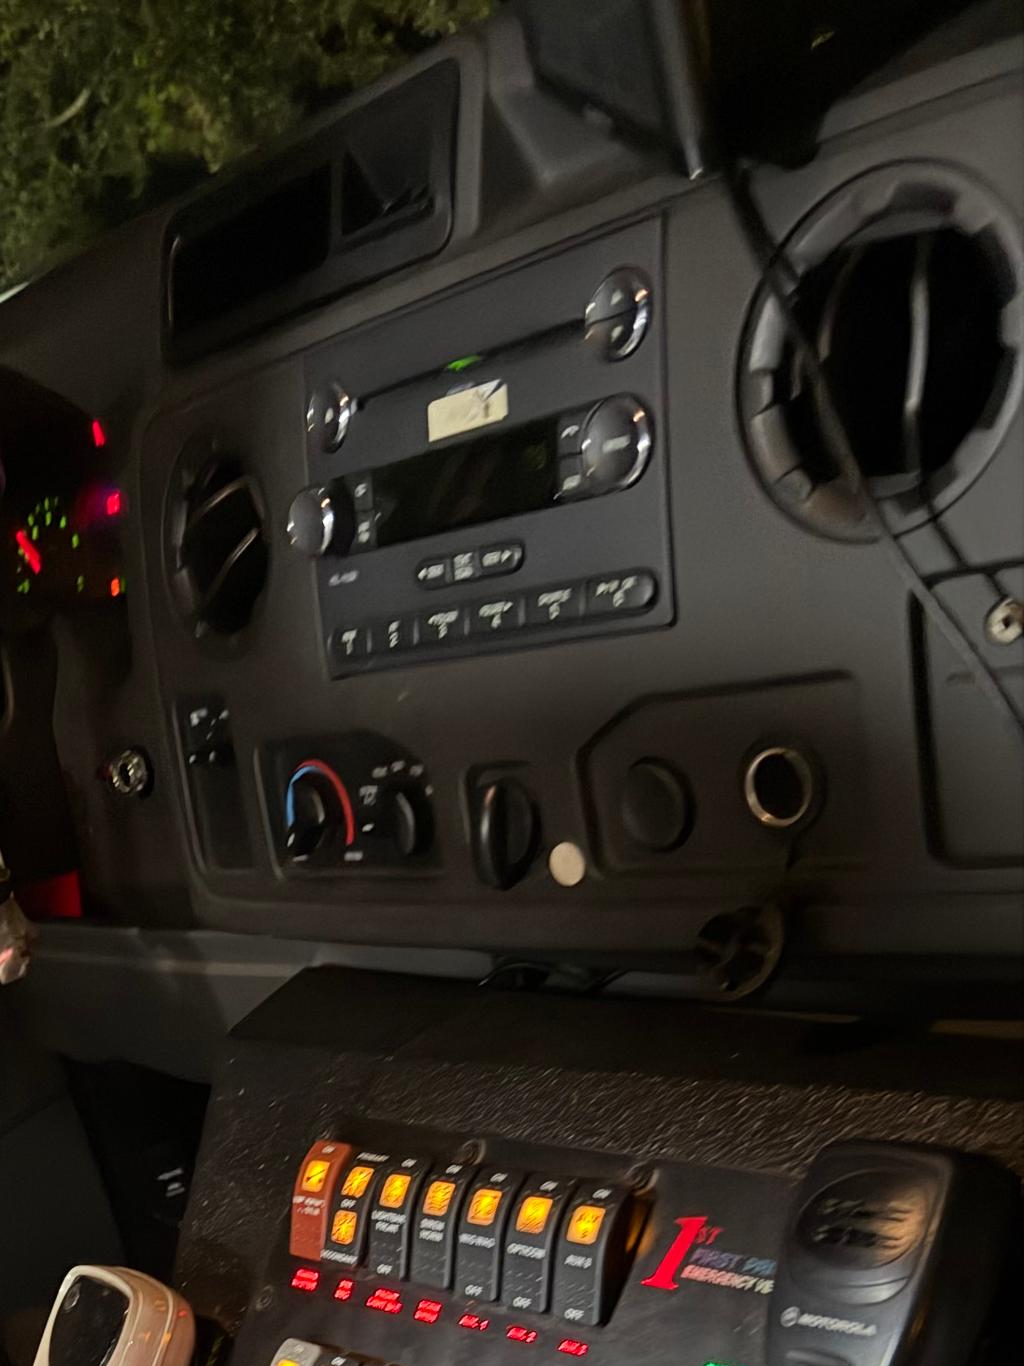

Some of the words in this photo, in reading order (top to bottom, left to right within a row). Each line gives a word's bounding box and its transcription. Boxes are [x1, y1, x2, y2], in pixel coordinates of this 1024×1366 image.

[680, 1264, 755, 1290] EMERGENCY
[465, 1284, 484, 1297] OFF
[512, 1296, 532, 1309] OFF
[564, 1307, 584, 1321] OFF
[797, 1313, 877, 1337] MOTOROLA
[331, 1356, 346, 1366] ON
